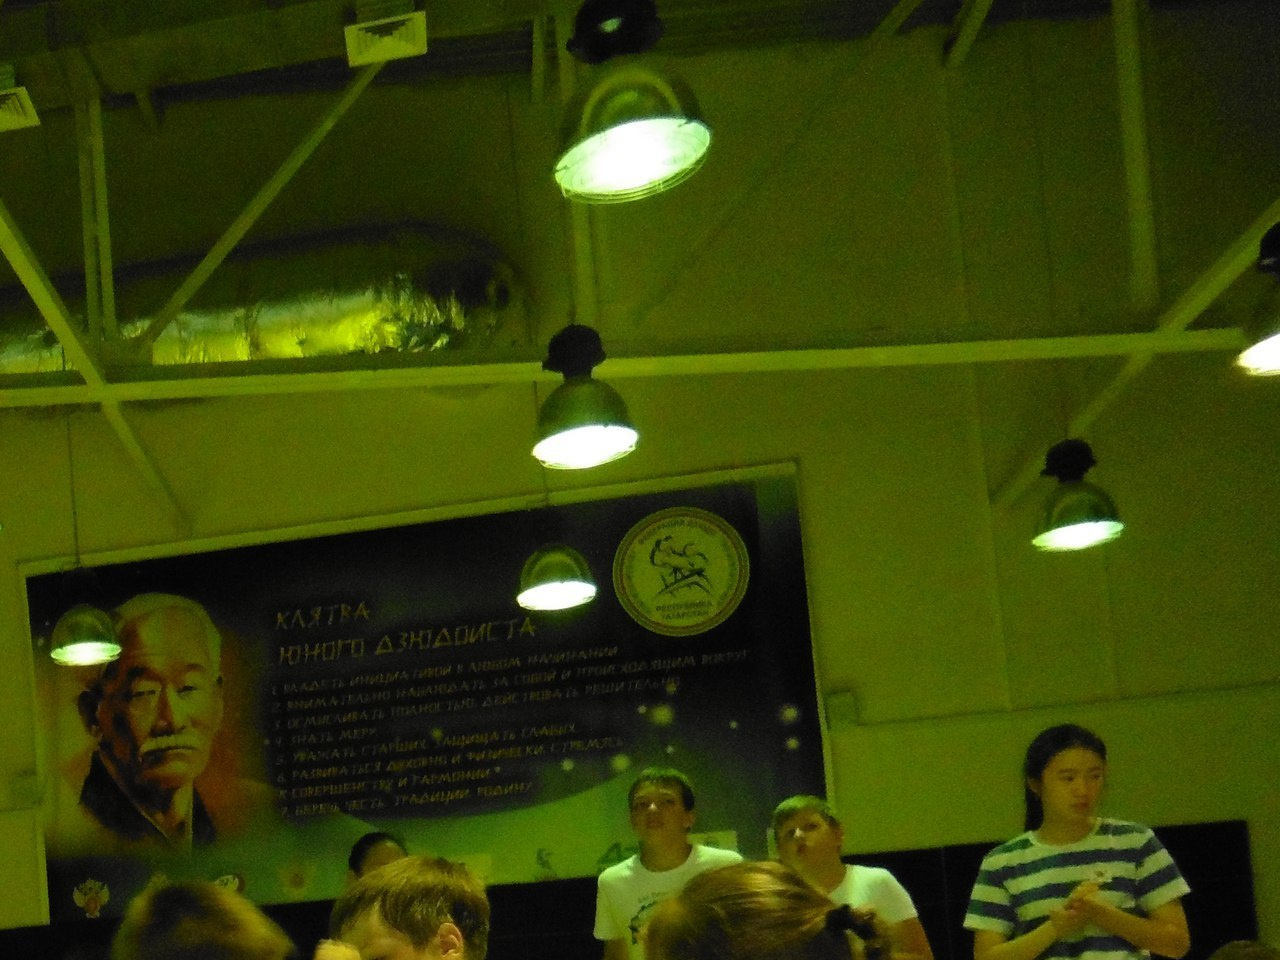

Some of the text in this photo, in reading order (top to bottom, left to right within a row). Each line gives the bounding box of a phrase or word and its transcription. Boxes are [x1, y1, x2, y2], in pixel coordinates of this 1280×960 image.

[275, 601, 371, 630] КЛЯТВА
[278, 617, 537, 666] ЮНОГО ДЗЮДОИСТА
